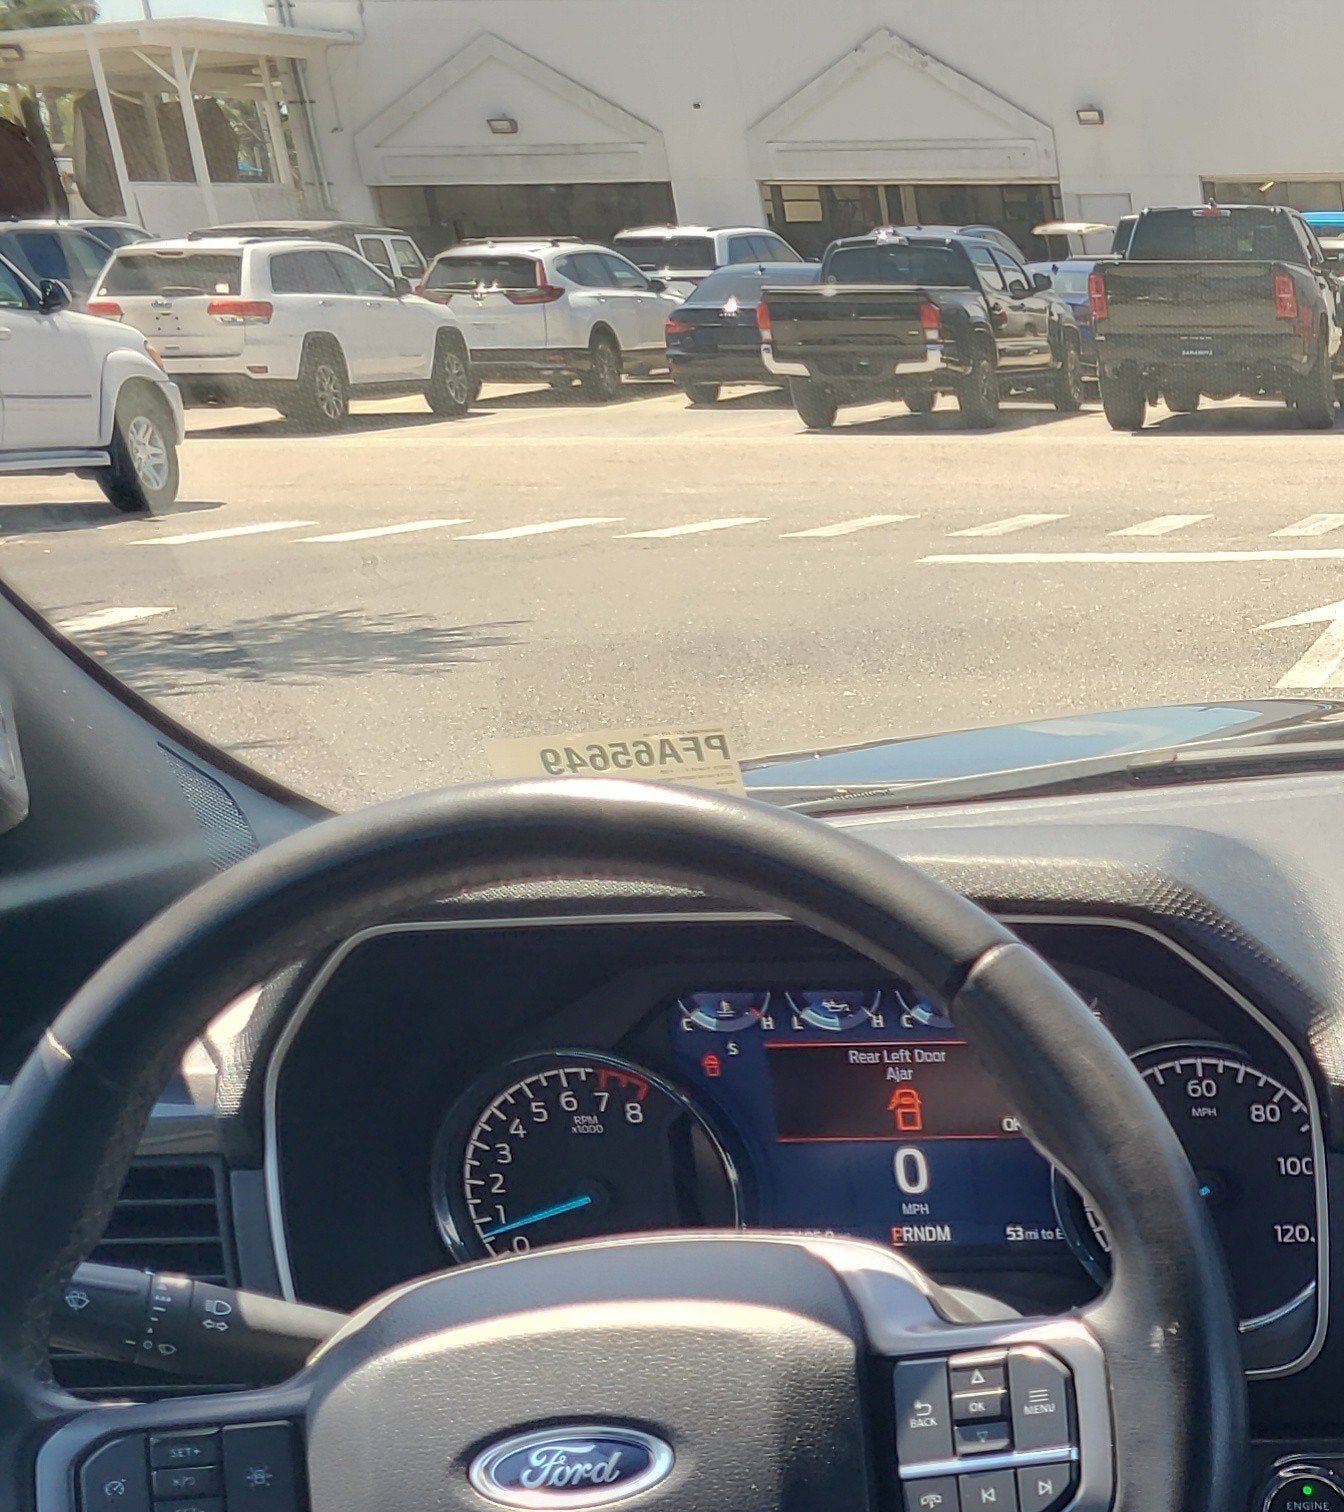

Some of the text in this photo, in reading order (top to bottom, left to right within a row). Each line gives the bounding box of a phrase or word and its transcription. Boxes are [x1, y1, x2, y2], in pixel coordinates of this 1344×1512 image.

[849, 1049, 946, 1064] Rear Left Door
[886, 1067, 913, 1082] Ajar
[1187, 1080, 1217, 1097] 60
[560, 1091, 578, 1111] 6
[593, 1092, 609, 1112] 7
[530, 1102, 548, 1123] 5
[574, 1115, 599, 1125] RPM
[625, 1102, 643, 1123] 8
[1191, 1107, 1217, 1117] MPH
[1250, 1103, 1281, 1123] 80
[509, 1118, 527, 1138] 4
[495, 1144, 512, 1163] 3
[894, 1147, 928, 1194] 0
[489, 1173, 506, 1193] 2
[494, 1205, 506, 1224] 1
[902, 1203, 929, 1215] MPH
[1006, 1226, 1024, 1240] 53
[1025, 1228, 1039, 1240] mi
[1040, 1228, 1054, 1240] to
[1274, 1224, 1309, 1243] 120
[969, 1402, 985, 1413] OK
[1023, 1403, 1056, 1415] MENU
[910, 1417, 938, 1429] BACK
[520, 1443, 622, 1488] Ford
[1286, 1502, 1330, 1511] ENGINE
